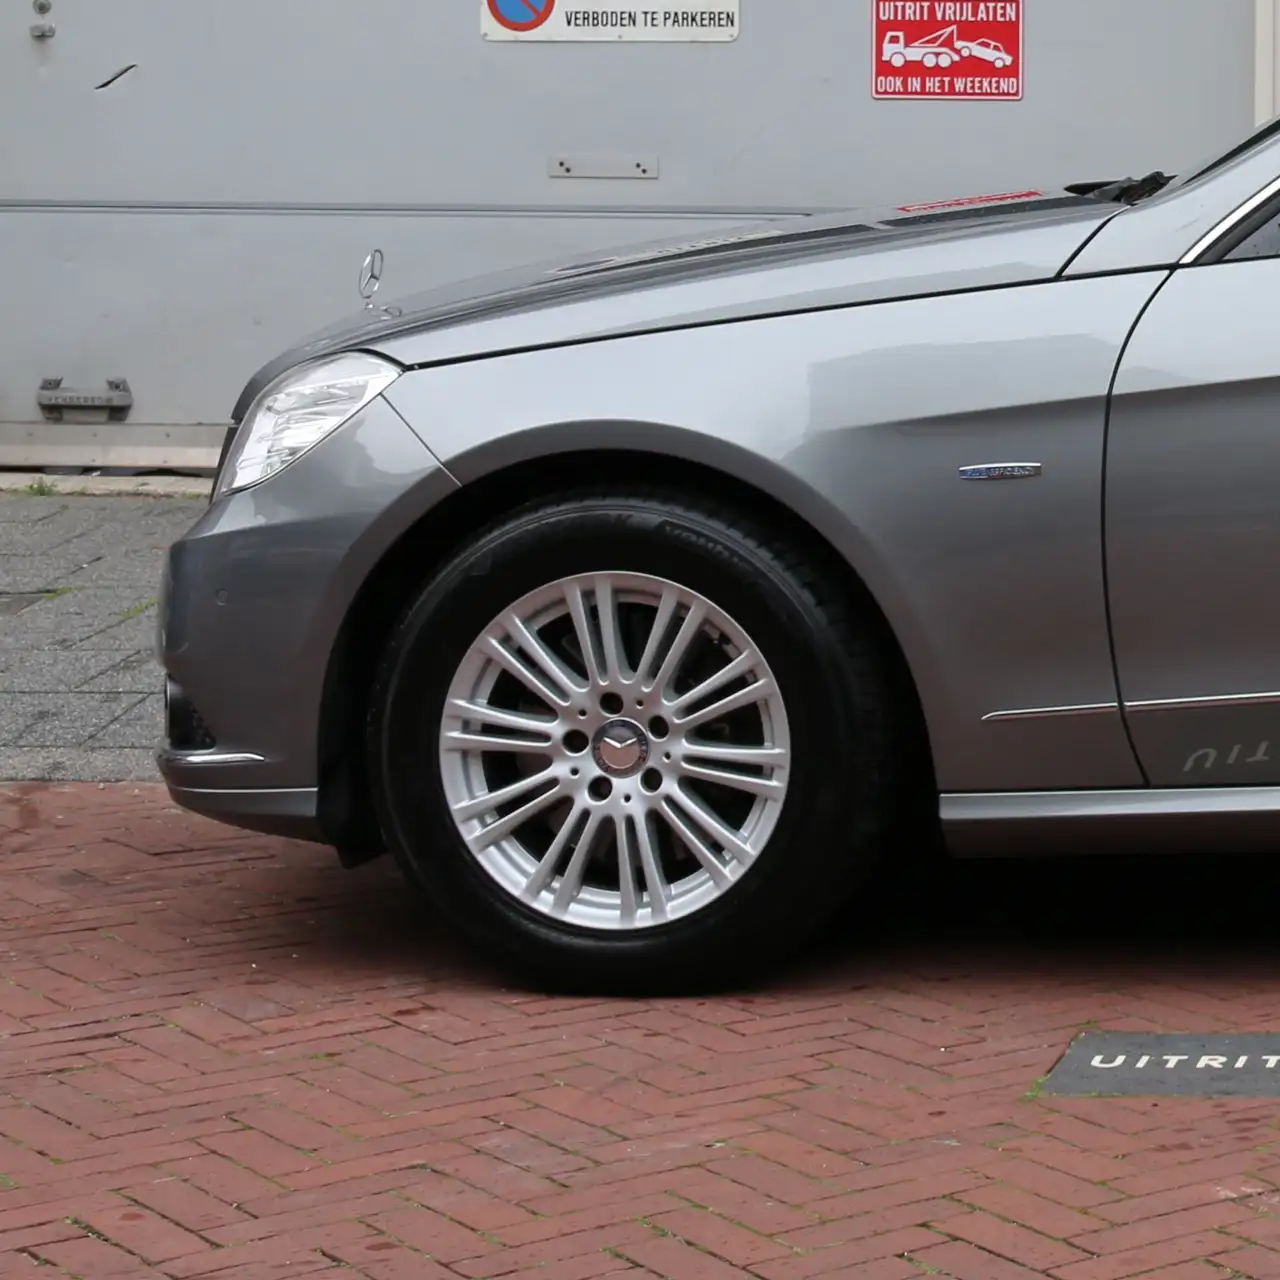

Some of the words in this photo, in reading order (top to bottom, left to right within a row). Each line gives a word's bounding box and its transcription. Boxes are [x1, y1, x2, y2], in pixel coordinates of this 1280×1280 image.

[565, 10, 636, 28] VERBODEN
[642, 11, 658, 28] TE
[663, 11, 735, 28] PARKEREN
[878, 1, 931, 21] UITRIT
[935, 2, 1016, 22] VRIJLATEN
[877, 76, 904, 93] OOK
[908, 76, 921, 93] IN
[926, 76, 950, 93] HET
[954, 77, 1018, 94] WEEKEND
